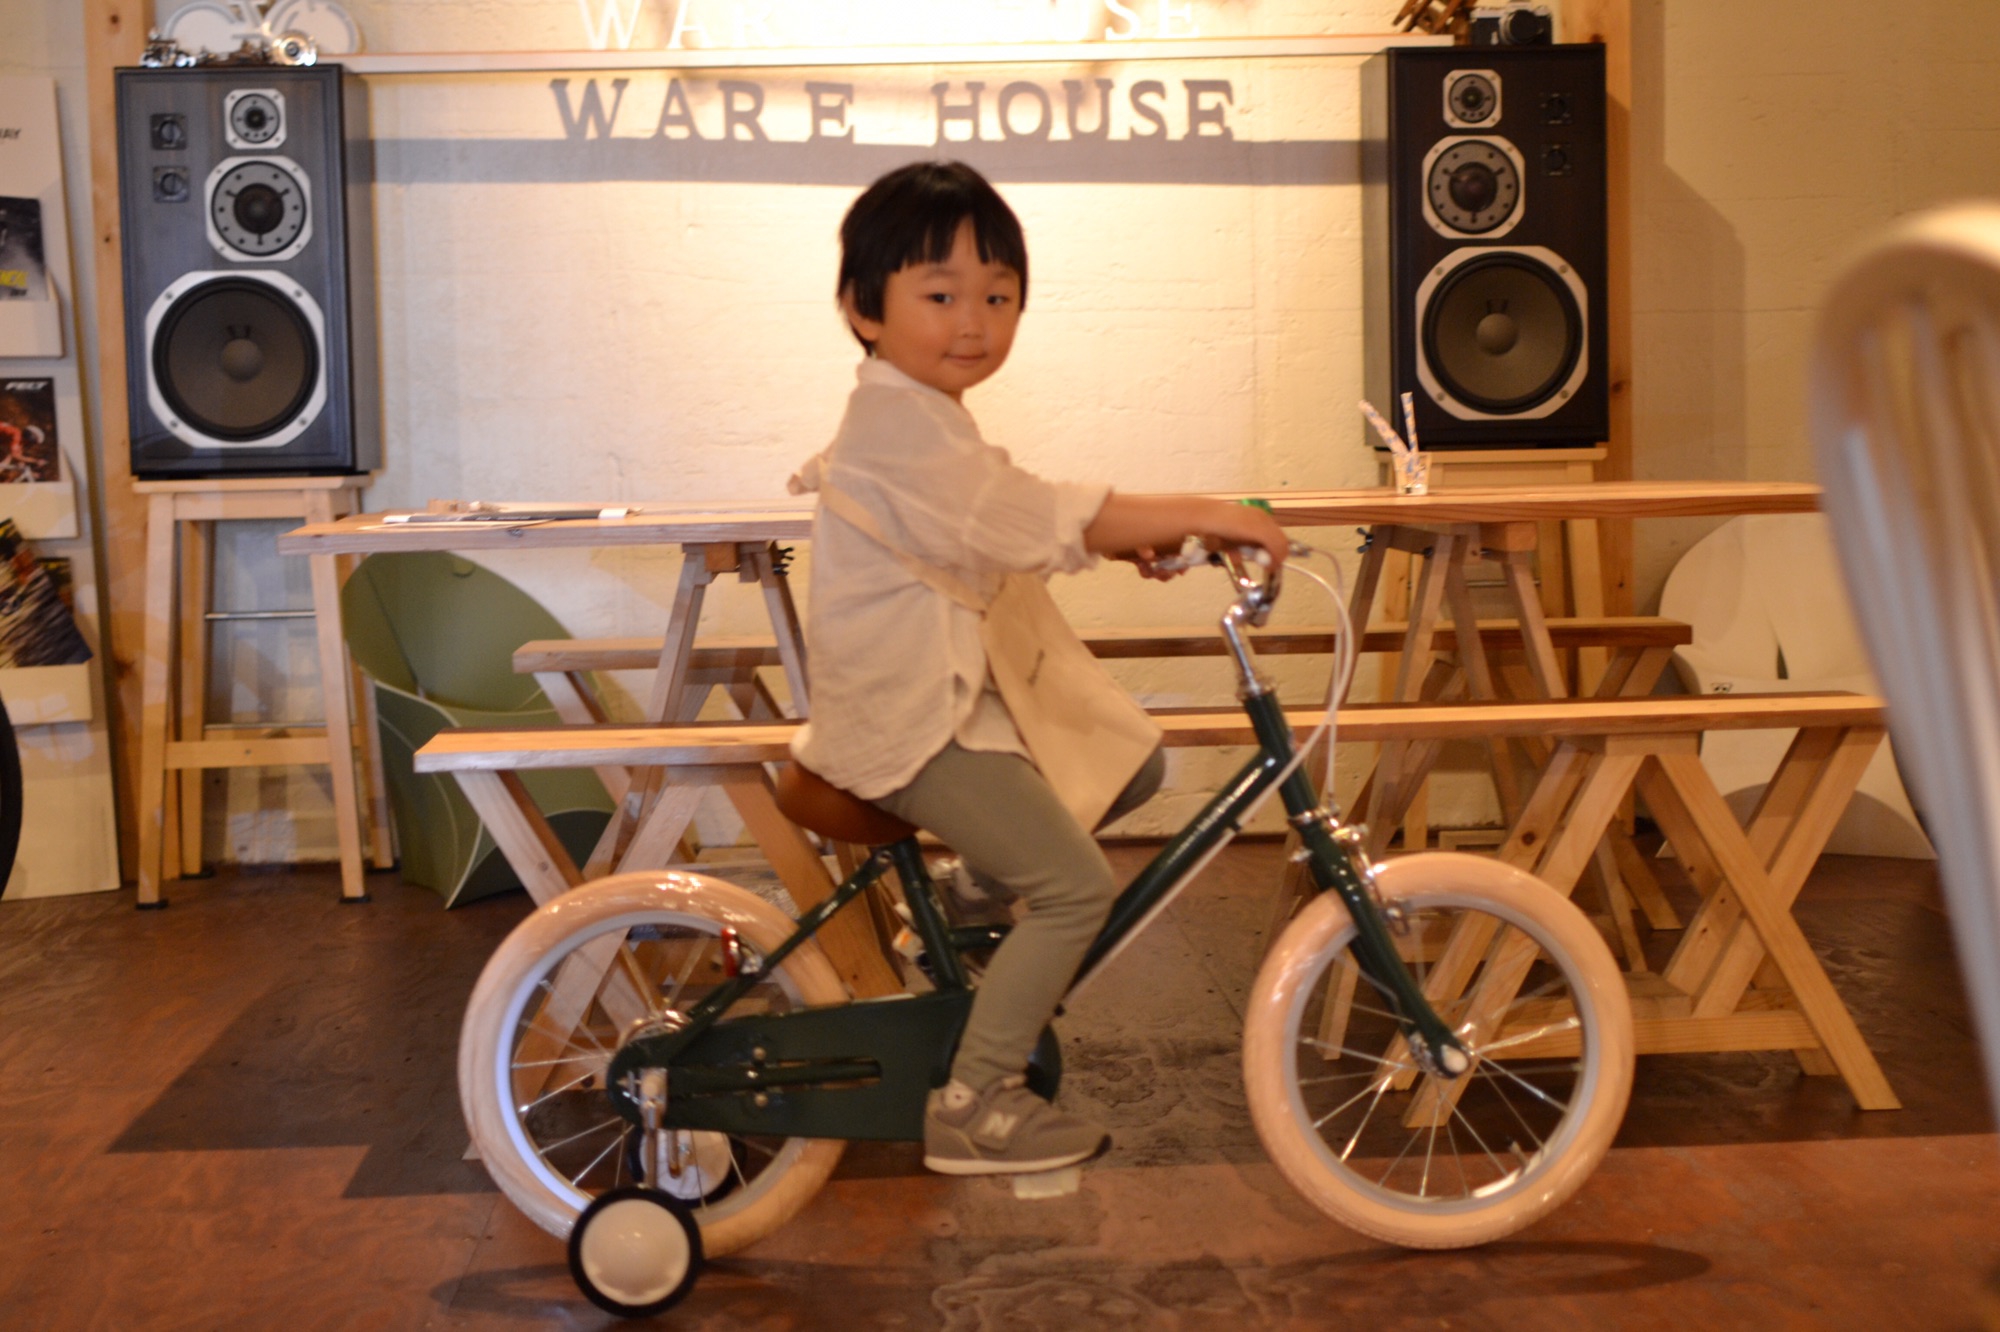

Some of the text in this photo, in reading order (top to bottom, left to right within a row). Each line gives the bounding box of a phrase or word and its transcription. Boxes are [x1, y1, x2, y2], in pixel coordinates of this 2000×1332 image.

[579, 0, 845, 50] WAR
[549, 77, 1234, 141] WARE HOUSE
[979, 1112, 1018, 1138] N
